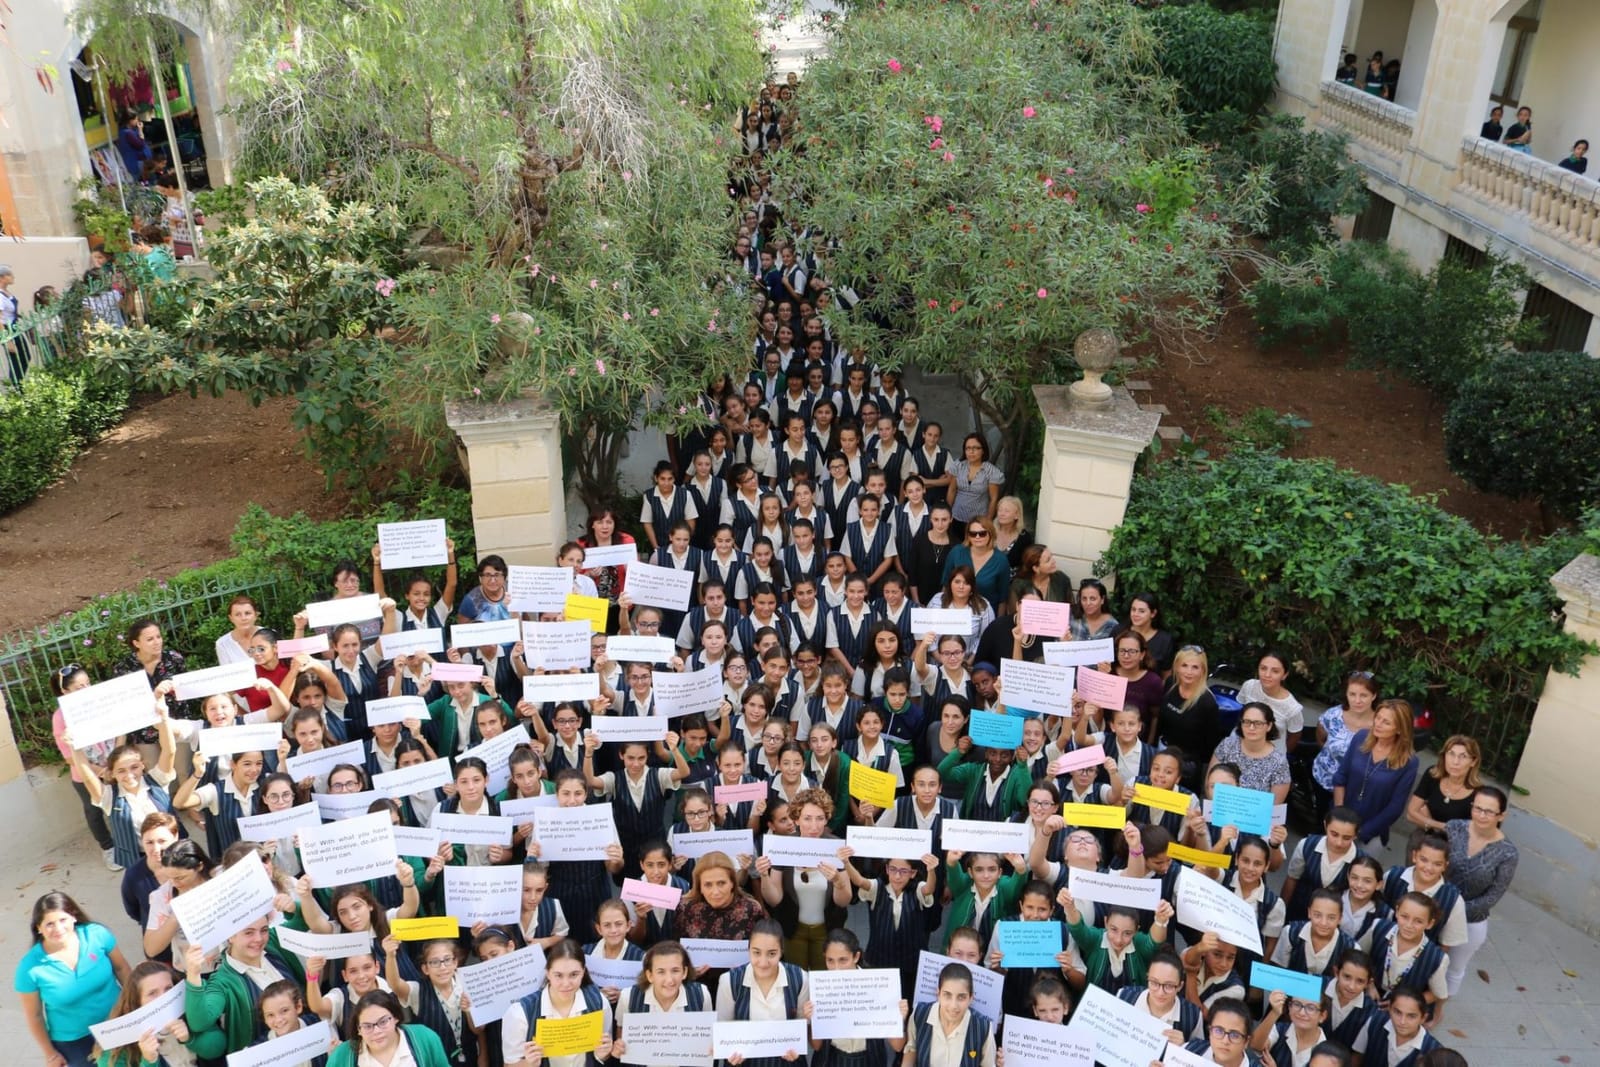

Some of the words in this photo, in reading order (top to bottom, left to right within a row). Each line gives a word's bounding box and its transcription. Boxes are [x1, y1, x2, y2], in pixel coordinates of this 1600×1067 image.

[947, 826, 1023, 837] #speakupagainstviolence
[852, 833, 925, 843] #speakupagainstviolence
[1074, 875, 1155, 893] #speakupagainstviolence
[719, 1036, 800, 1045] #speakupagainstviolence
